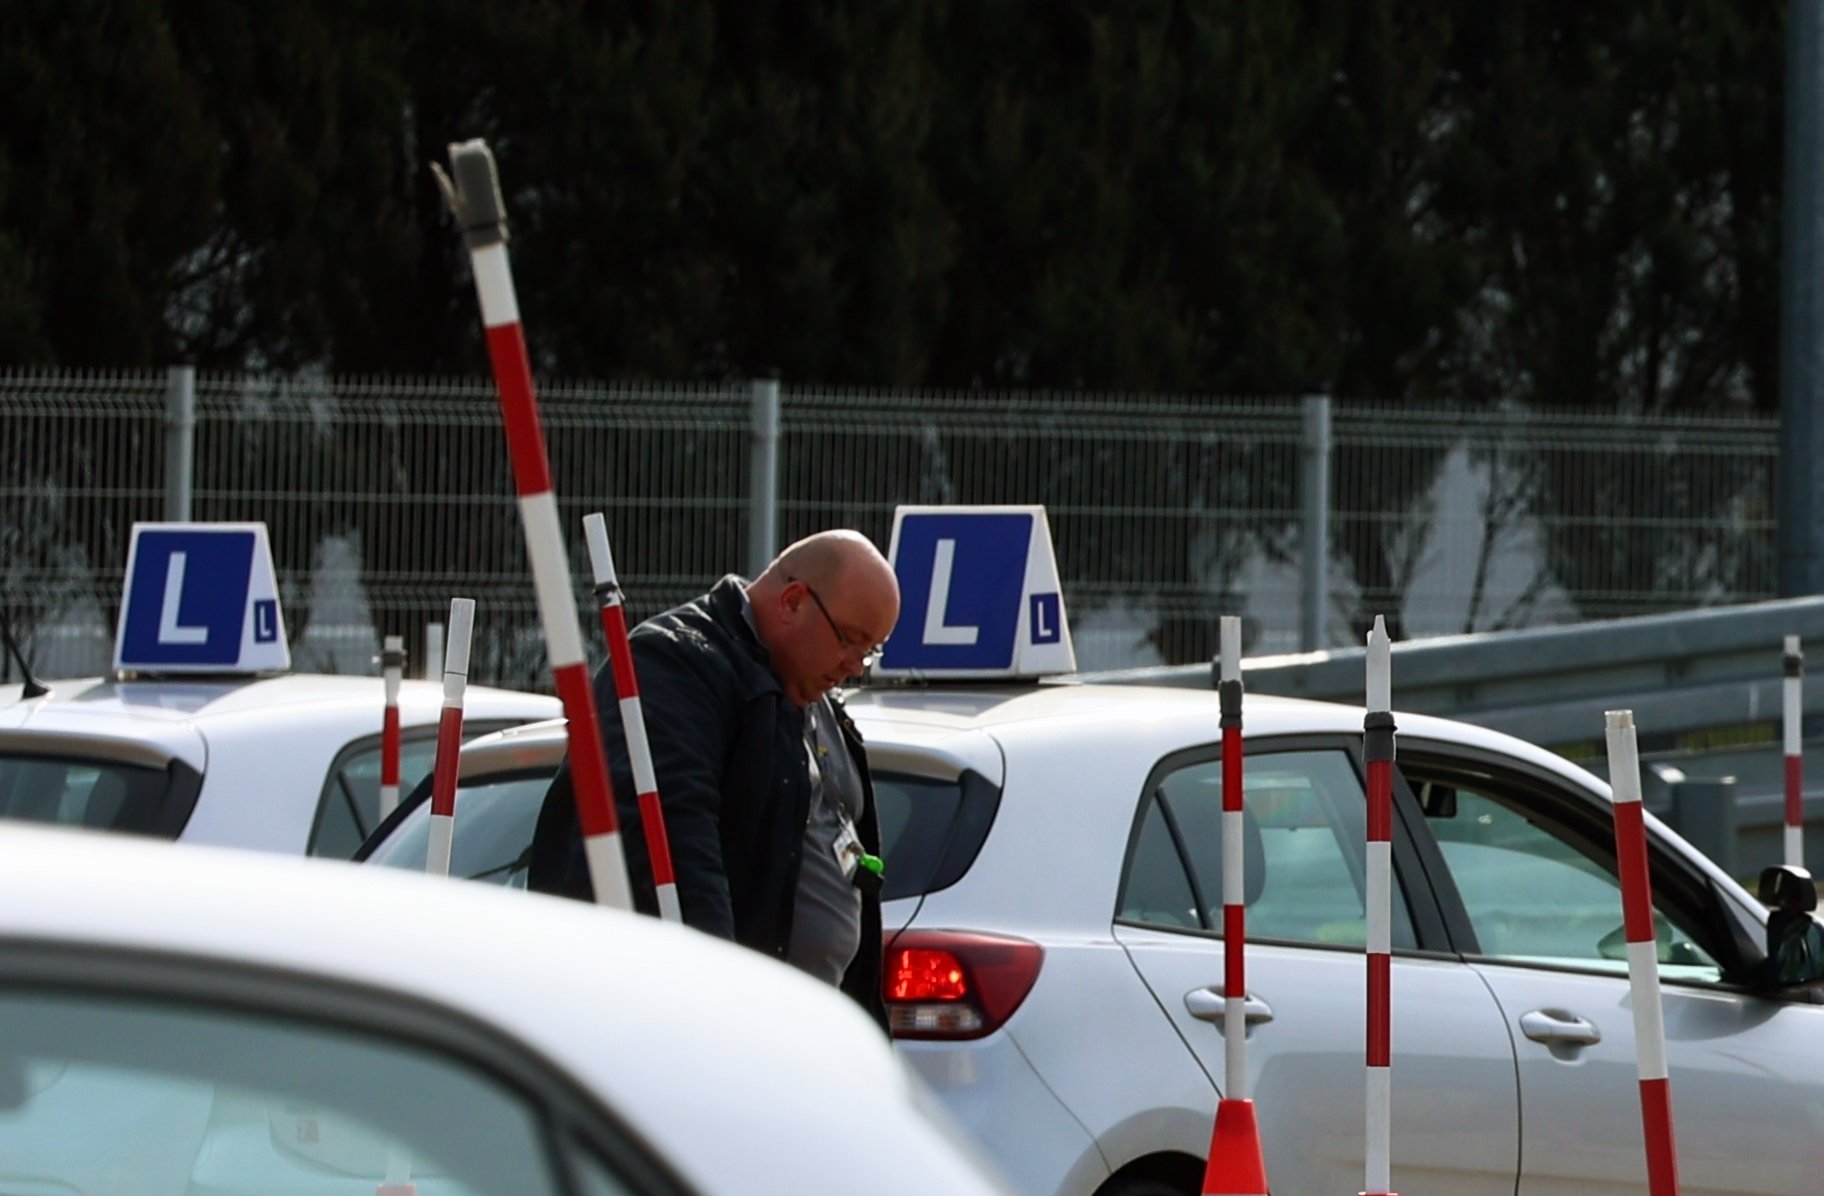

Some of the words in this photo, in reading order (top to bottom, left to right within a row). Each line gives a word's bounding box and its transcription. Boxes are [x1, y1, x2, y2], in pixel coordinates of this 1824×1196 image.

[157, 551, 208, 645] L
[259, 604, 272, 638] L
[922, 538, 979, 645] L
[1037, 601, 1052, 637] L
